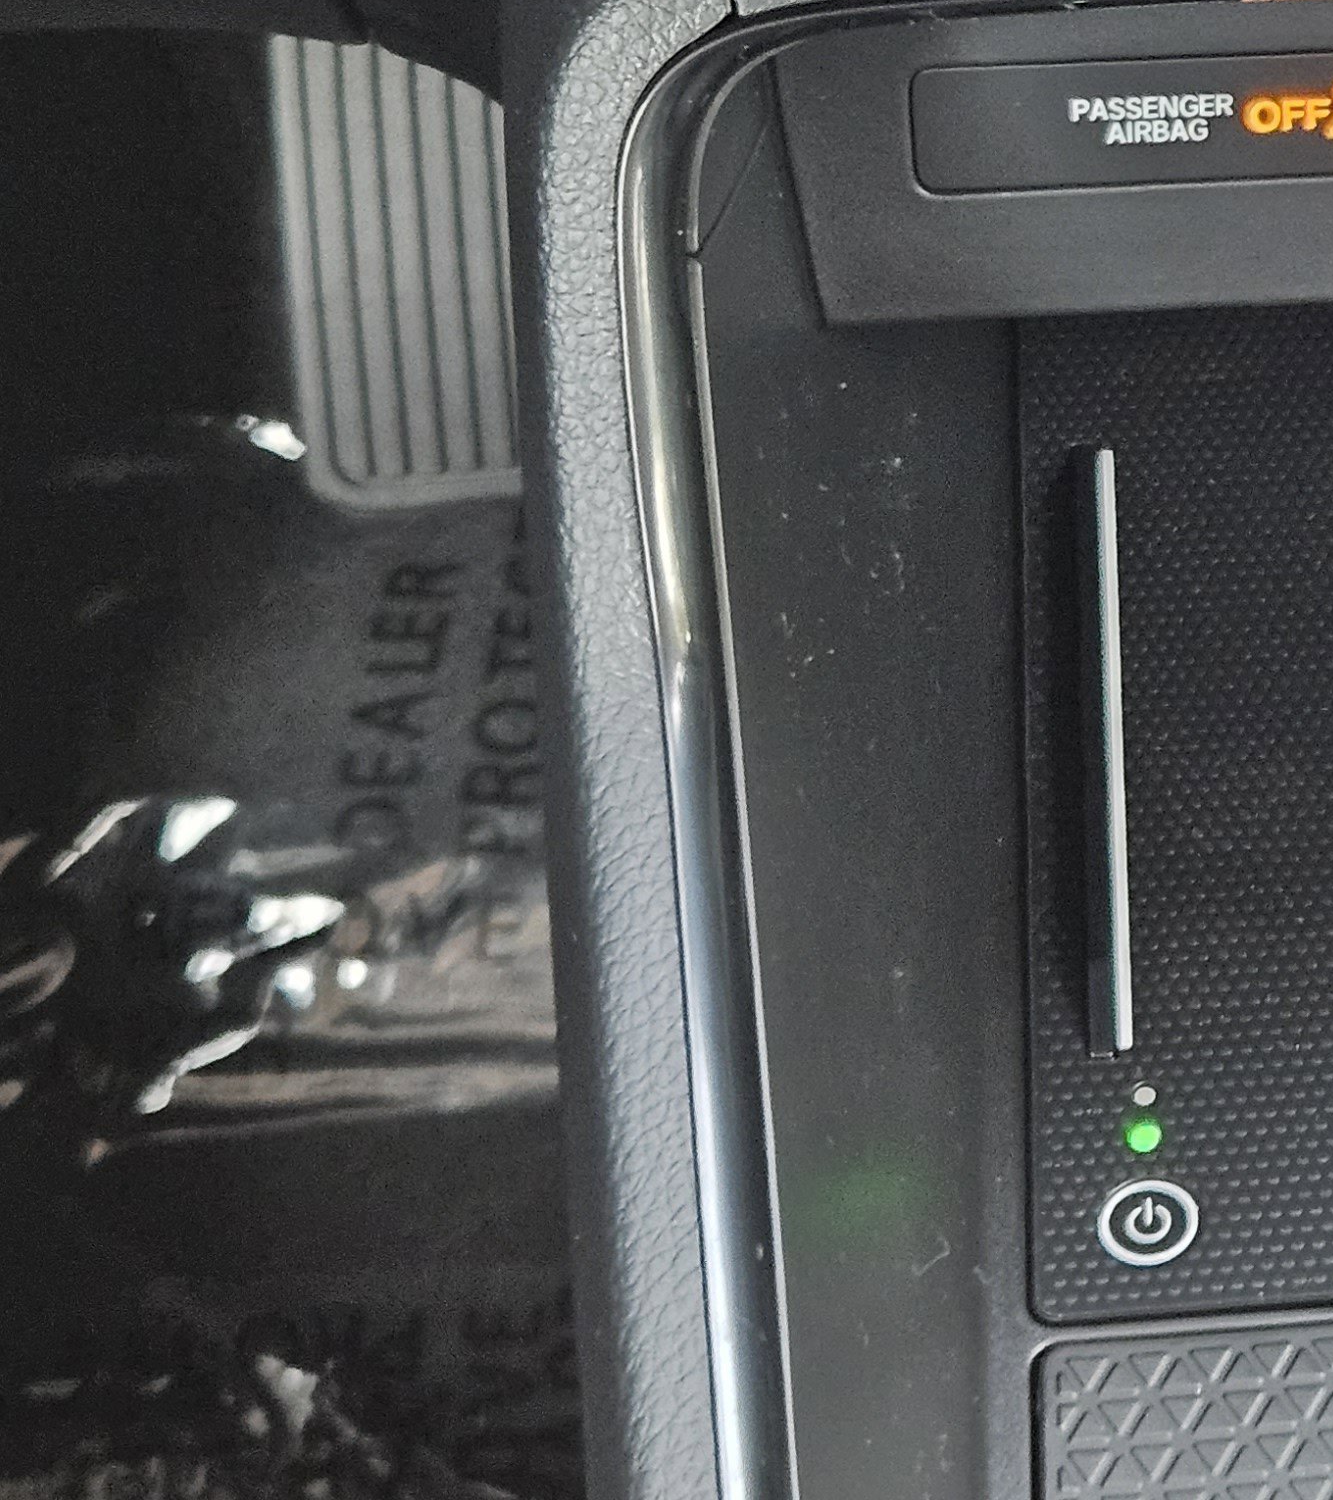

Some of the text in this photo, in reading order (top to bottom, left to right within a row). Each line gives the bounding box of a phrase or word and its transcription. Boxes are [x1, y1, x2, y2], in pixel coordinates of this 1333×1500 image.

[1068, 93, 1331, 134] PASSENGER OFF
[1104, 117, 1210, 145] AIRBAG
